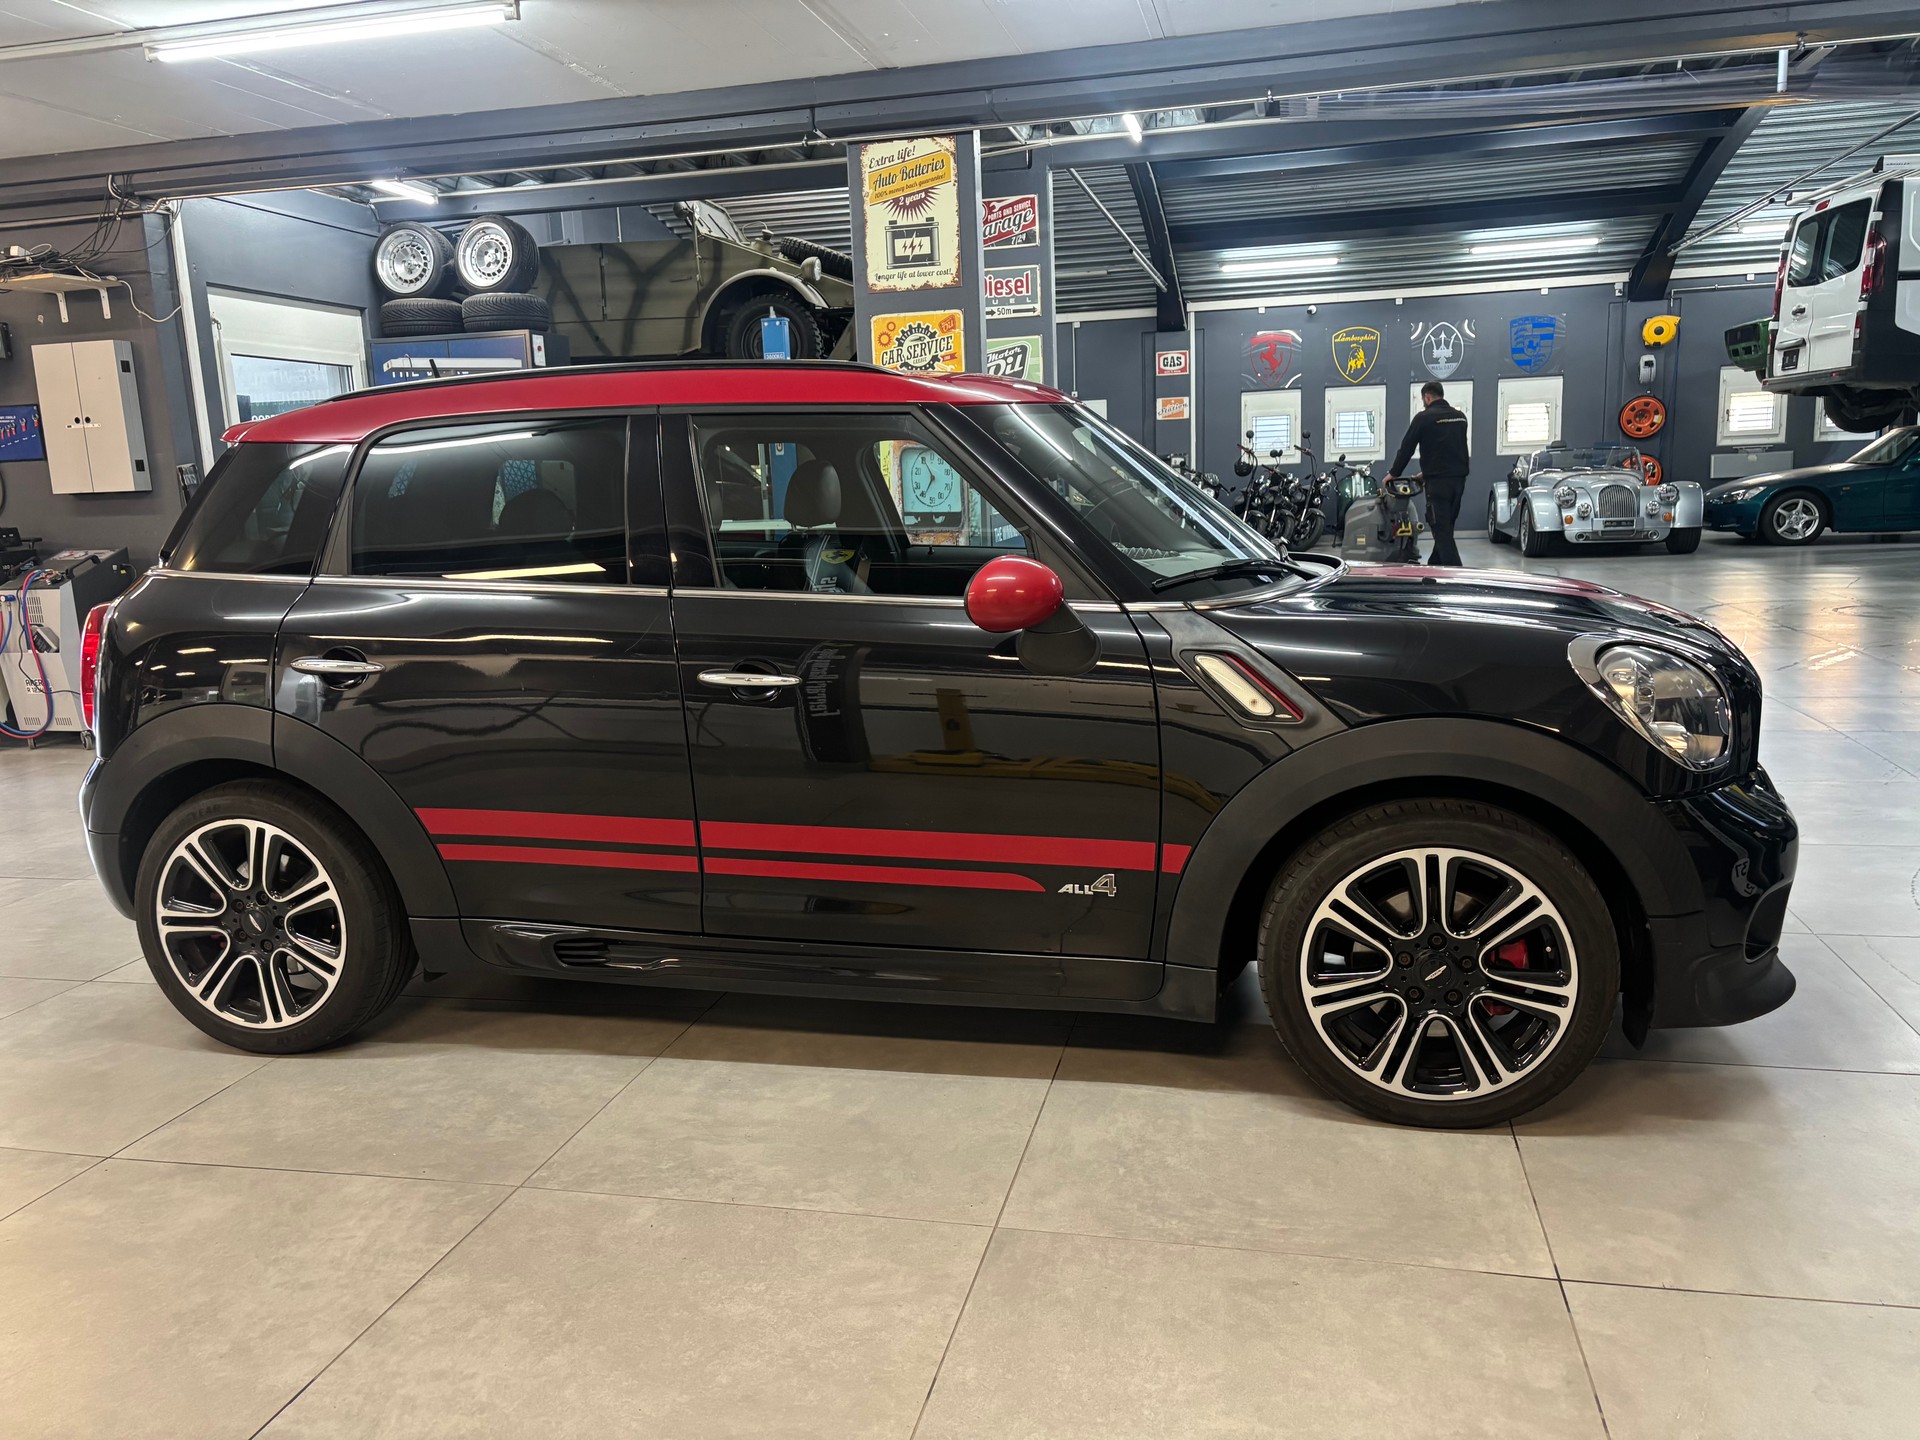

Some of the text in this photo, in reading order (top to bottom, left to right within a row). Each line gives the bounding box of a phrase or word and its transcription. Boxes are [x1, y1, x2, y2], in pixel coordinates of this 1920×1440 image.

[868, 145, 916, 169] Extra life!
[873, 158, 945, 191] Auto Batteries
[875, 190, 888, 199] 100%
[906, 182, 918, 190] back
[899, 191, 926, 206] 2 years
[987, 200, 1031, 222] PARTS AND SERVICE
[982, 209, 1033, 238] arage
[875, 272, 896, 282] Longer
[897, 271, 908, 280] life
[917, 269, 934, 277] lower
[936, 267, 952, 276] cost!
[992, 297, 1031, 305] UEL
[996, 307, 1012, 315] 50m
[1335, 331, 1379, 343] Lamborghini
[881, 335, 953, 366] CAR SERVICE
[987, 346, 1022, 363] Motor
[986, 354, 1024, 377] Oil
[1162, 356, 1182, 368] GAS
[915, 467, 921, 475] 20
[914, 481, 920, 490] 30
[945, 482, 951, 491] 70
[930, 496, 935, 504] 50
[1057, 873, 1117, 897] ALL4
